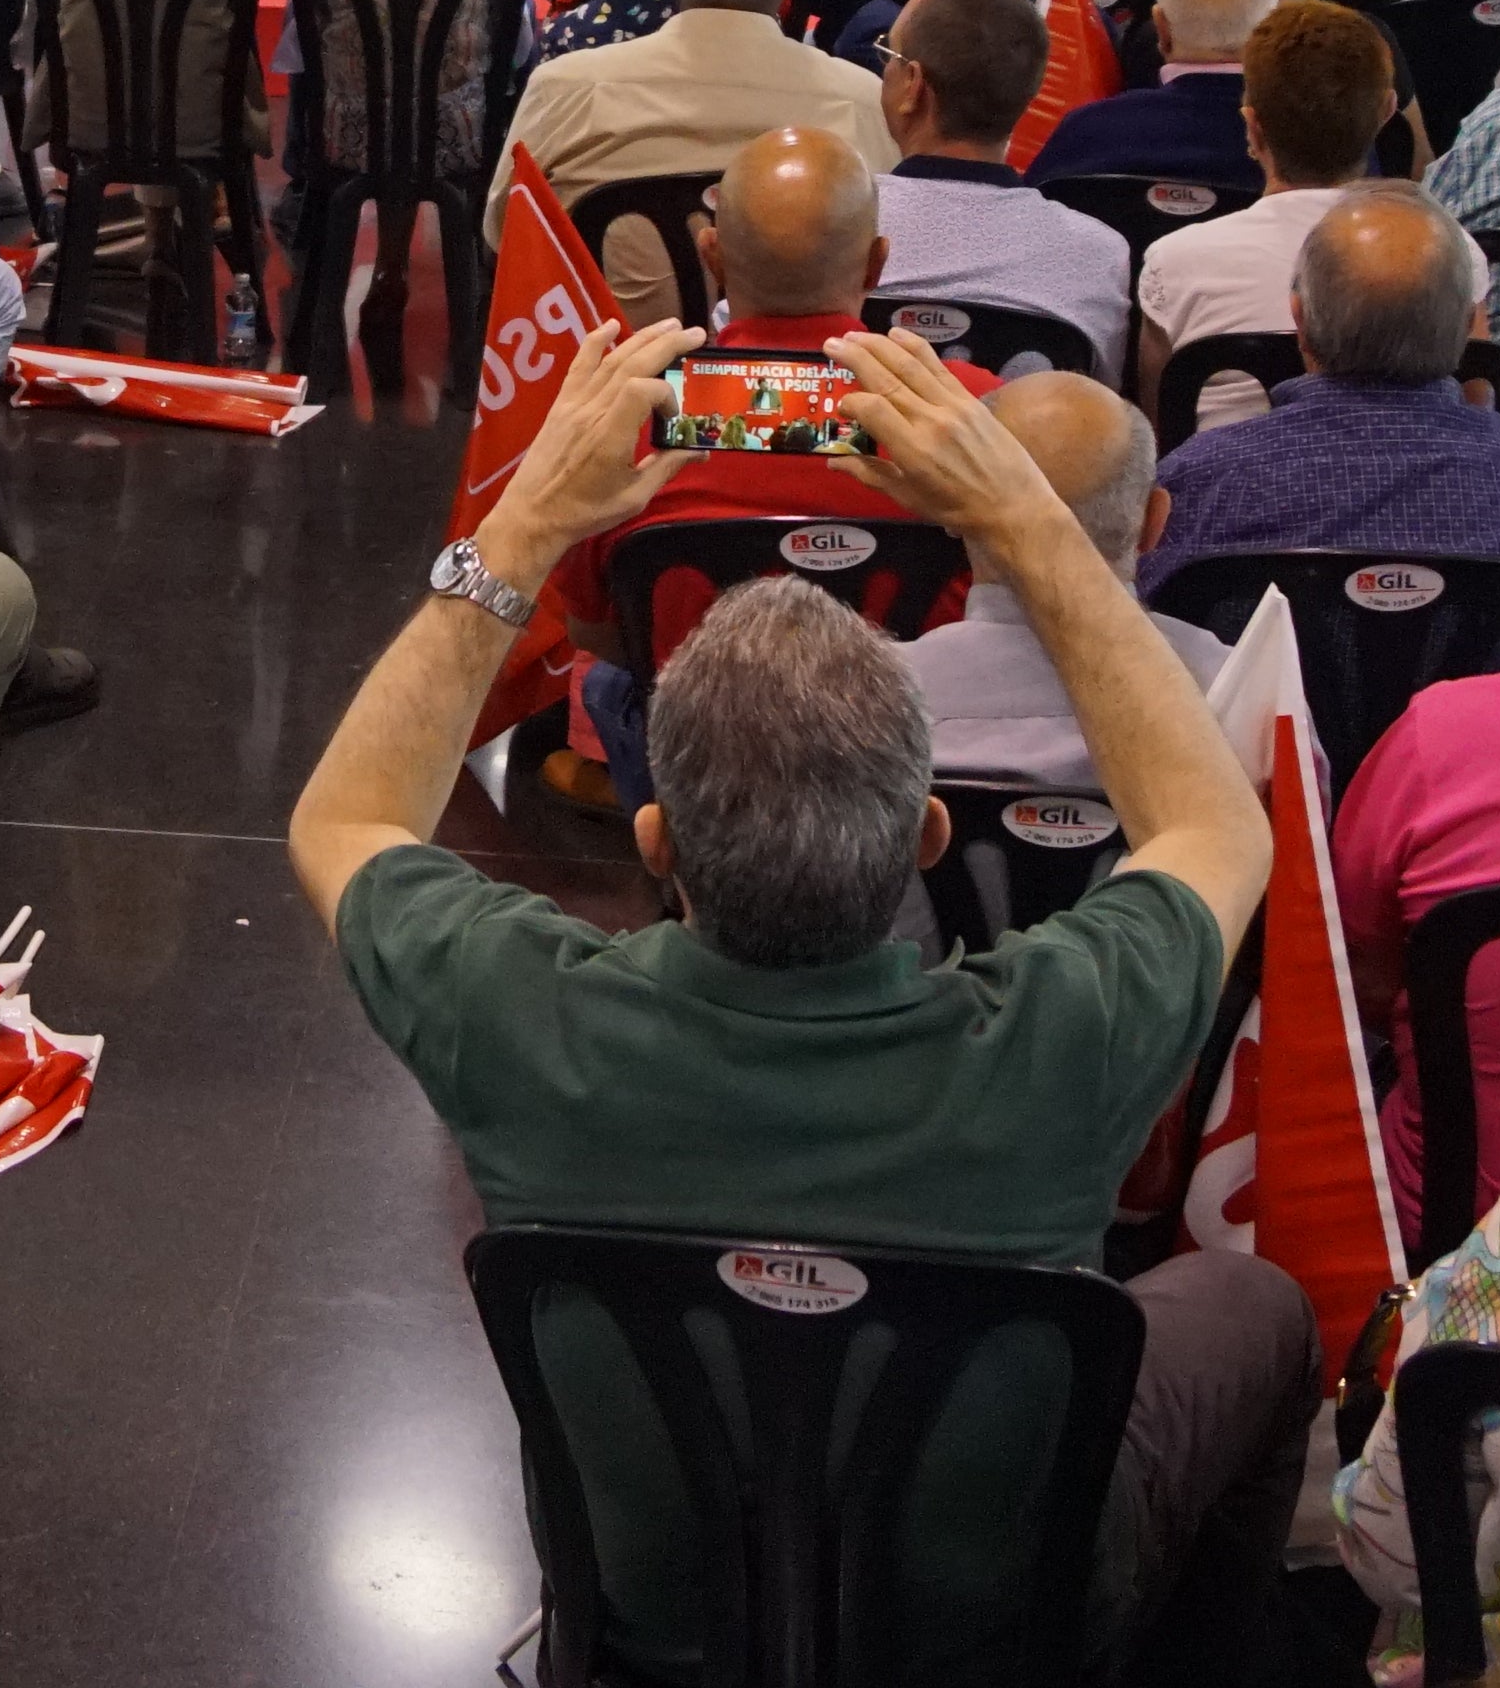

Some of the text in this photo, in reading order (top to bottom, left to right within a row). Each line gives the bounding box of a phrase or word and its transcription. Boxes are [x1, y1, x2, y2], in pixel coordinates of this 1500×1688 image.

[692, 363, 747, 376] SIEMPRE
[751, 366, 795, 378] HACIA
[785, 378, 820, 392] PSOE
